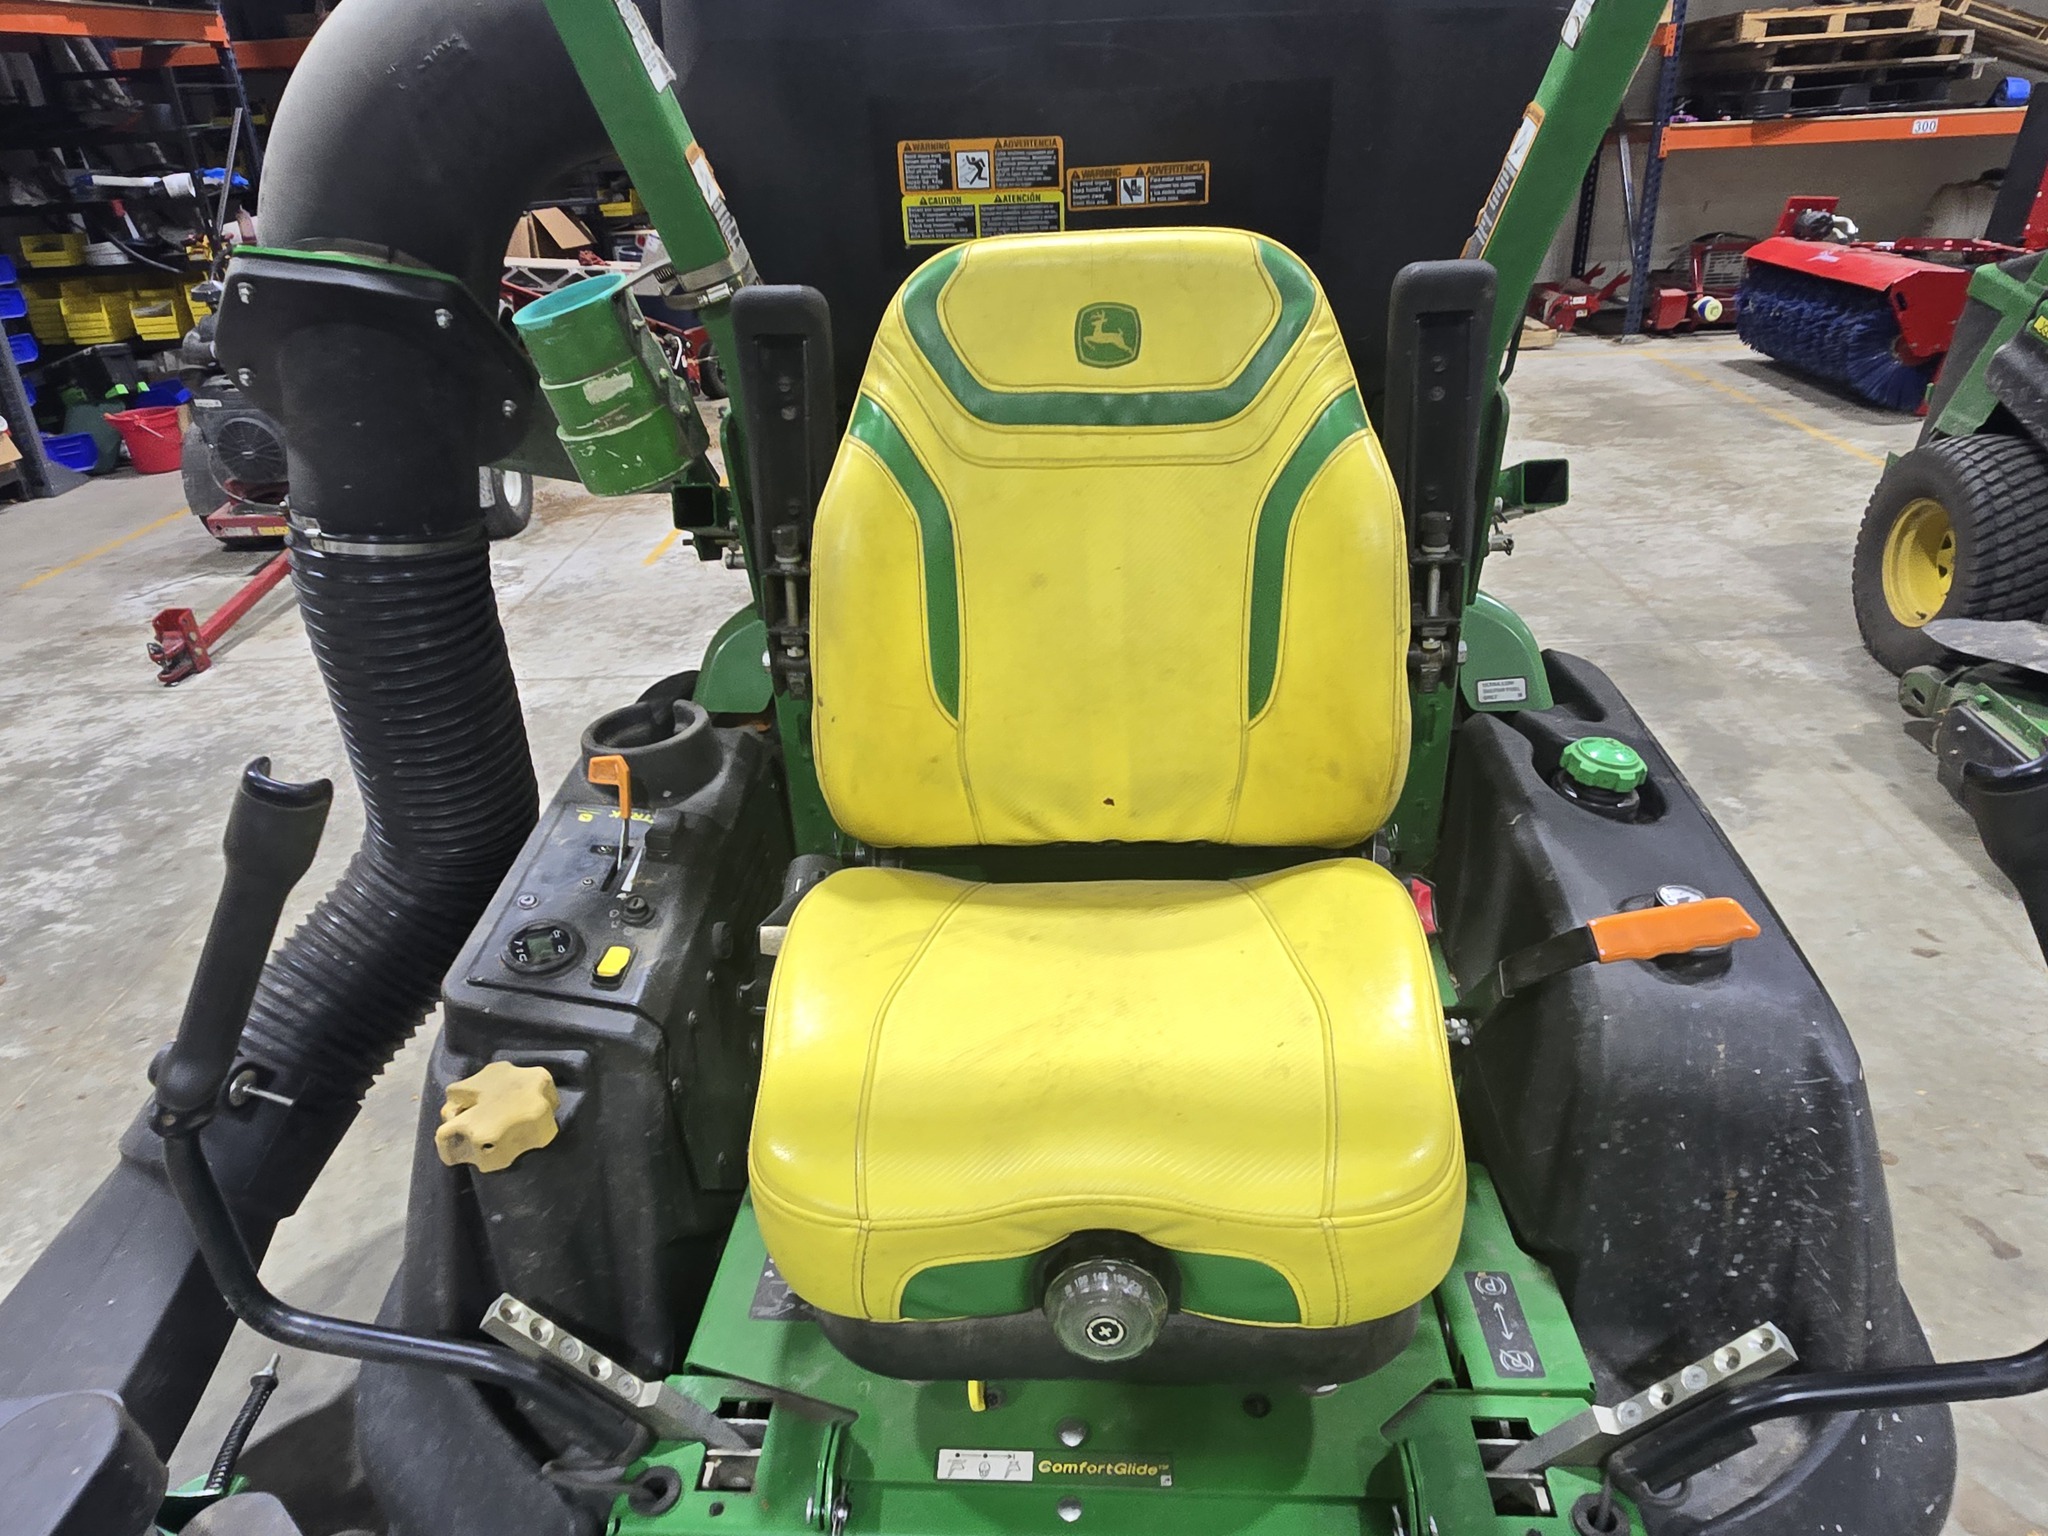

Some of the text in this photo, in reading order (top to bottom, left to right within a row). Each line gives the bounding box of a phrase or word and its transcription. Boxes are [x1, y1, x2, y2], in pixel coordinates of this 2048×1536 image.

[1915, 121, 1936, 133] 300
[911, 142, 950, 152] WARNING
[1003, 138, 1057, 148] ADVERTENCIA
[1081, 168, 1122, 178] WARNING
[1146, 163, 1206, 175] ADVERTENCIA
[928, 196, 961, 205] CAUTION
[1003, 192, 1040, 202] ATENCIÓN
